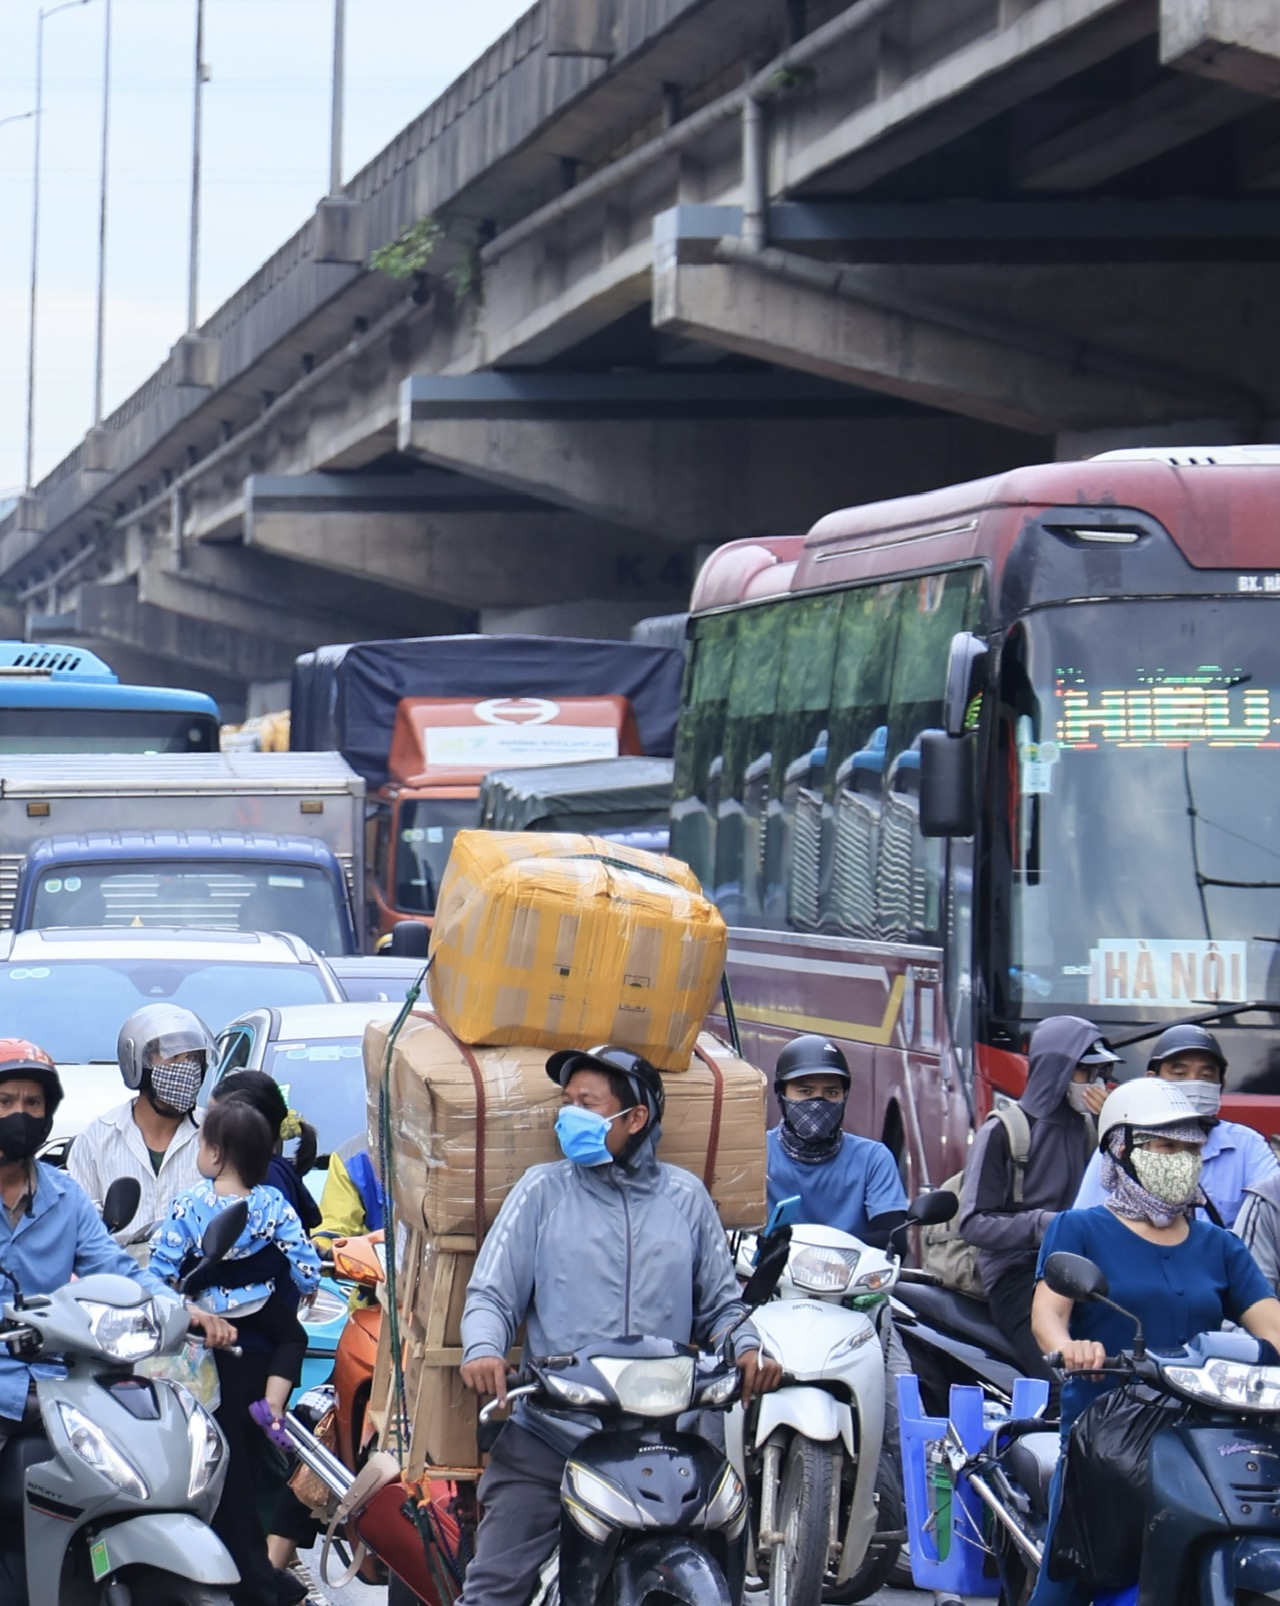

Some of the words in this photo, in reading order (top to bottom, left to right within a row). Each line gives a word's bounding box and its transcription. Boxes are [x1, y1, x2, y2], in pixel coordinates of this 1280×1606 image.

[1238, 575, 1262, 591] BX.
[1104, 940, 1157, 999] HÀ
[792, 1303, 824, 1313] HONDA
